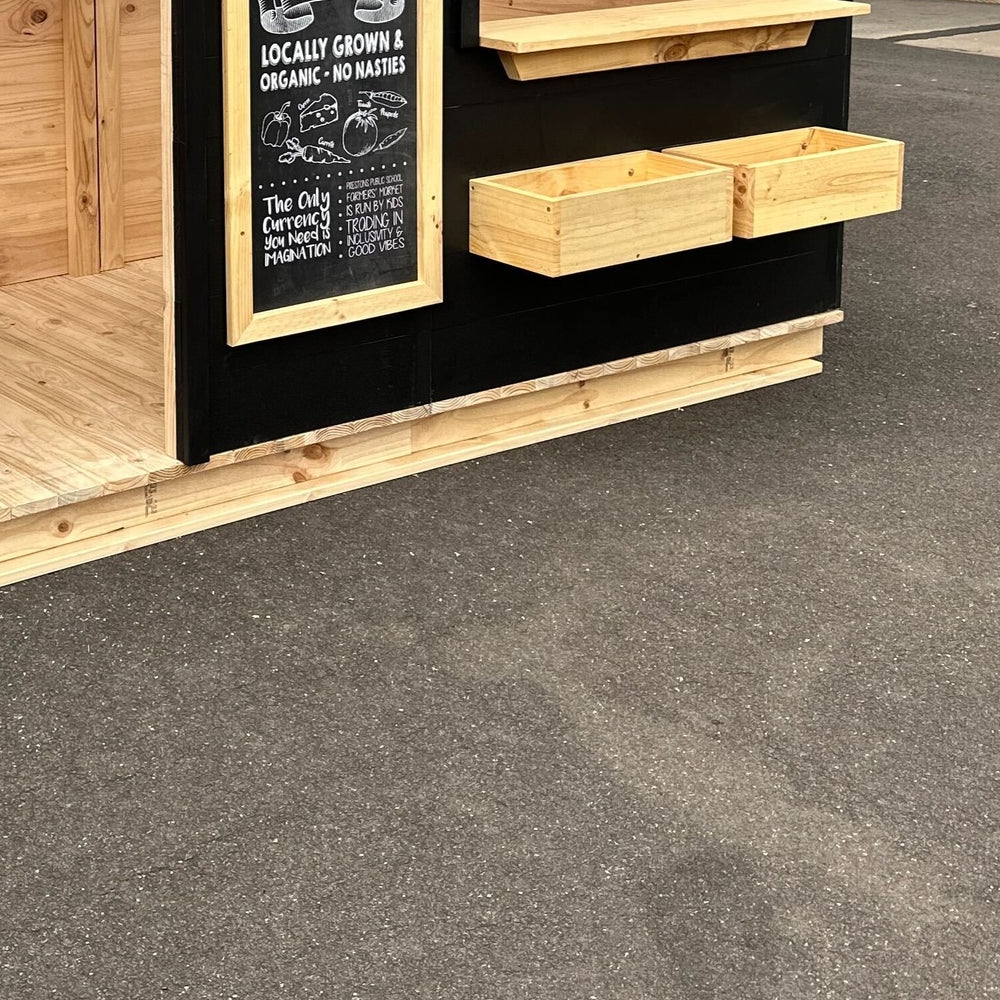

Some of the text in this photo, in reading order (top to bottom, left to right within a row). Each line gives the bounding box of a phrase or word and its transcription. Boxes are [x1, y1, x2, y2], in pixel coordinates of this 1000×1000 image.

[261, 29, 404, 68] LOCALLY GROWN &
[260, 66, 321, 92] ORGANIC
[332, 62, 351, 83] NO
[355, 55, 406, 80] NASTIES
[262, 187, 330, 215] The Only
[346, 195, 404, 217] IS RUN BY KIDS
[262, 210, 331, 234] Currency
[393, 209, 403, 226] IN
[288, 225, 319, 246] Need
[396, 226, 404, 238] &
[264, 241, 331, 267] IMAGINATION
[348, 237, 405, 258] GOOD VIBES
